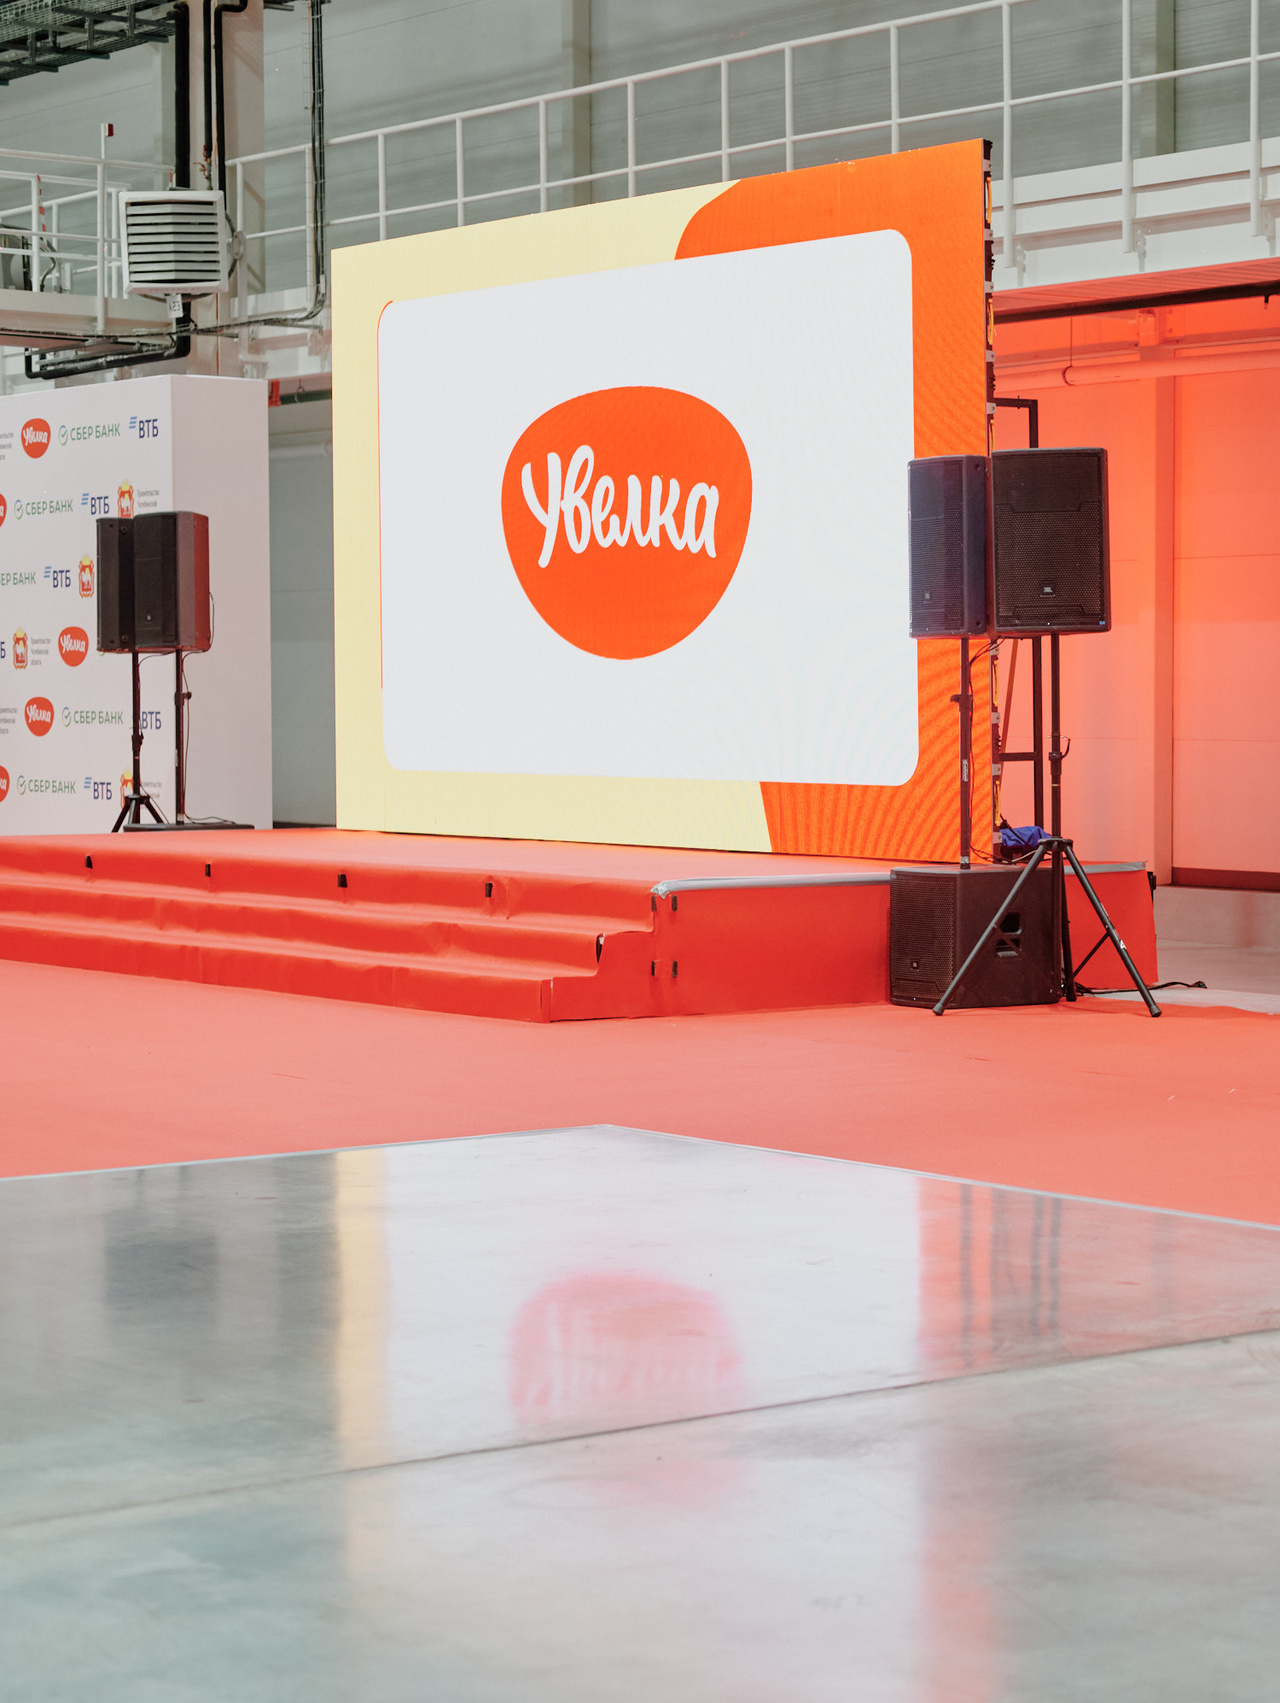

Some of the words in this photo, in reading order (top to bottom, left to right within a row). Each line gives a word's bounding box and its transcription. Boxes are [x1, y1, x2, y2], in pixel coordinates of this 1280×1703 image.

[70, 426, 93, 441] СБЕР
[95, 423, 121, 438] БАНК
[139, 419, 159, 439] ВТБ
[25, 501, 48, 515] СБЕР
[50, 499, 73, 513] БАНК
[90, 496, 110, 515] ВТБ
[521, 445, 719, 568] Увелка
[13, 572, 36, 586] БАНК
[53, 570, 71, 588] ВТБ
[73, 711, 96, 724] СБЕР
[99, 711, 124, 724] БАНК
[142, 711, 162, 730] ВТБ
[28, 779, 49, 793] СБЕР
[51, 780, 76, 794] БАНК
[93, 782, 113, 800] ВТБ
